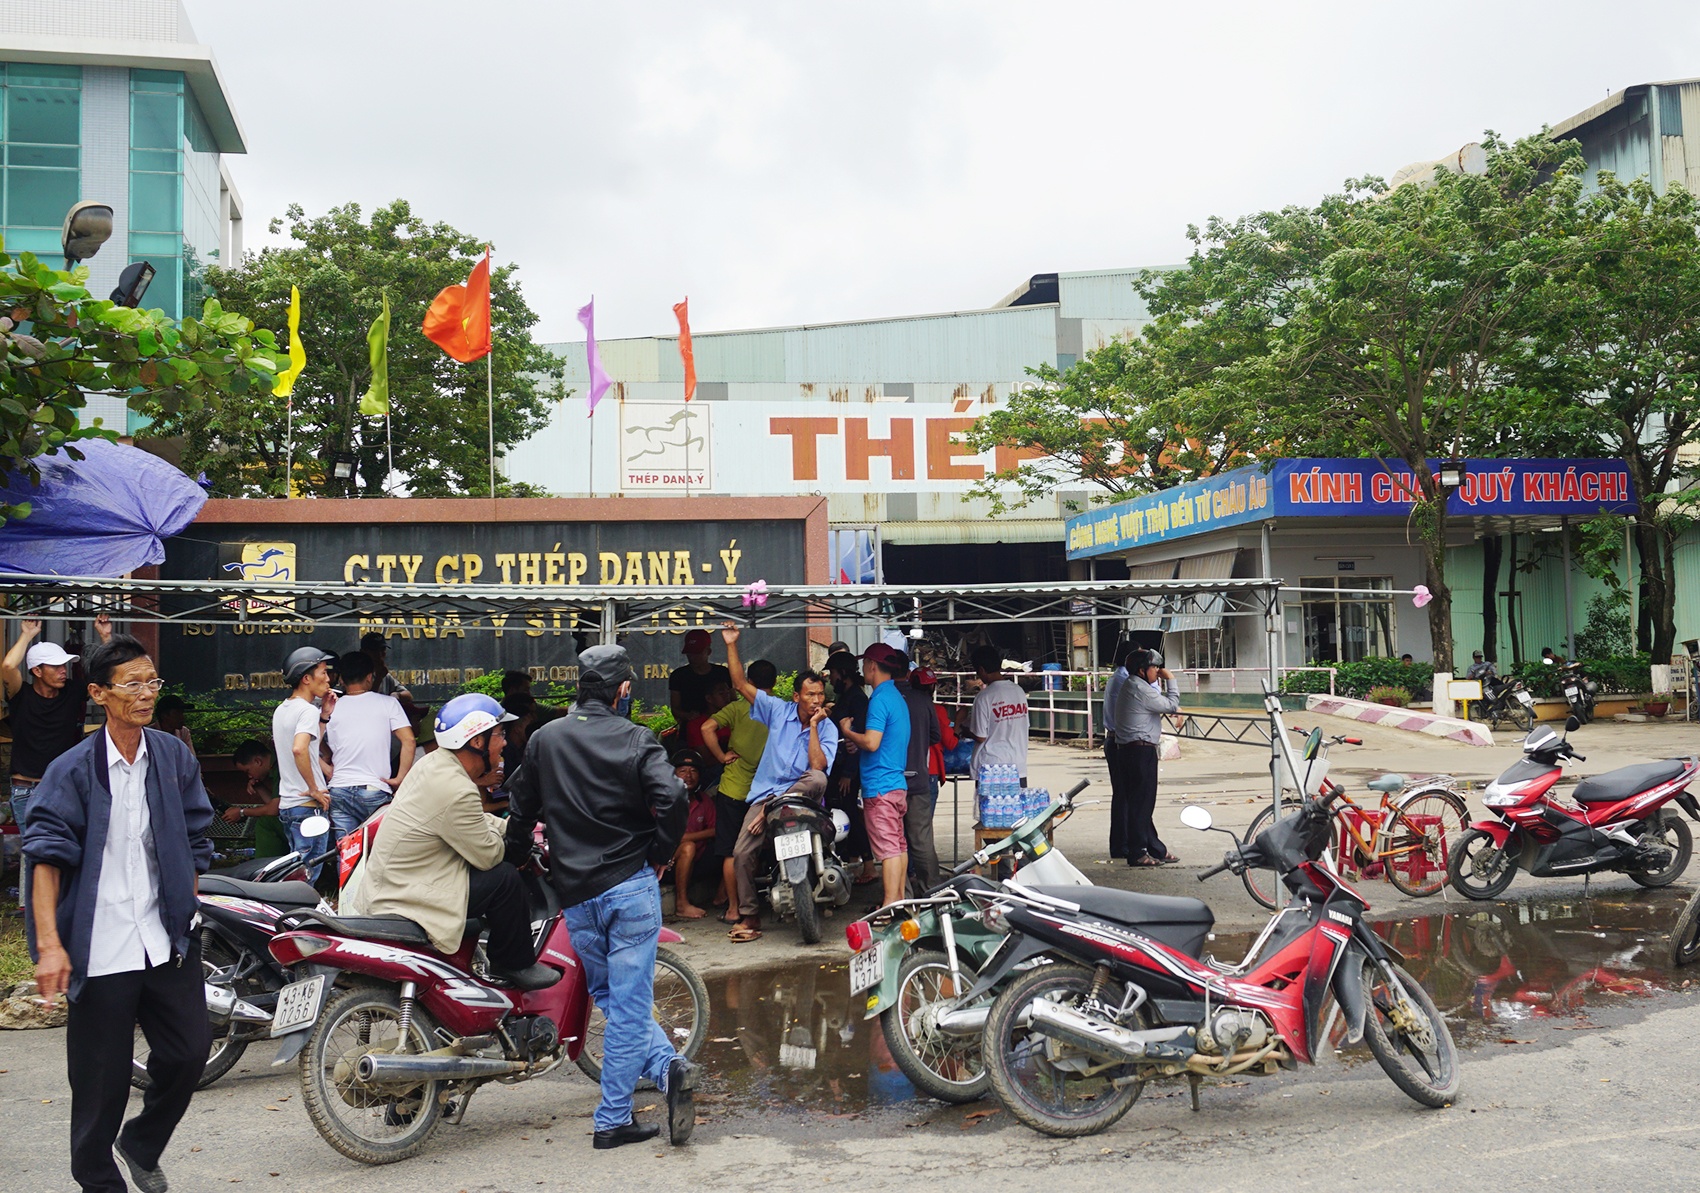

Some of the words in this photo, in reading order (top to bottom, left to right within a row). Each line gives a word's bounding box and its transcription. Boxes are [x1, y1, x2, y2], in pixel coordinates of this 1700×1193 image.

[628, 472, 659, 484] THÉP
[1289, 466, 1363, 503] KÍNH
[1458, 466, 1515, 506] QUÝ
[1523, 466, 1628, 502] KHÁCH!
[1070, 522, 1094, 551] CÔNG
[1094, 512, 1119, 547] NGHỆ
[1119, 509, 1144, 542] VƯỢT
[1145, 500, 1169, 537] TRỘI
[1170, 491, 1194, 529] ĐẾN
[1195, 488, 1211, 523] TỪ
[1212, 480, 1246, 519] CHÂU
[1248, 474, 1267, 511] ÂU
[344, 554, 424, 588] CTY
[435, 553, 483, 589] CP
[495, 542, 588, 587] THÉP
[182, 619, 217, 636] ISO
[781, 844, 806, 858] 0998
[1328, 909, 1353, 926] YAMAHA
[546, 948, 576, 967] HONDA
[280, 1001, 310, 1026] 0256
